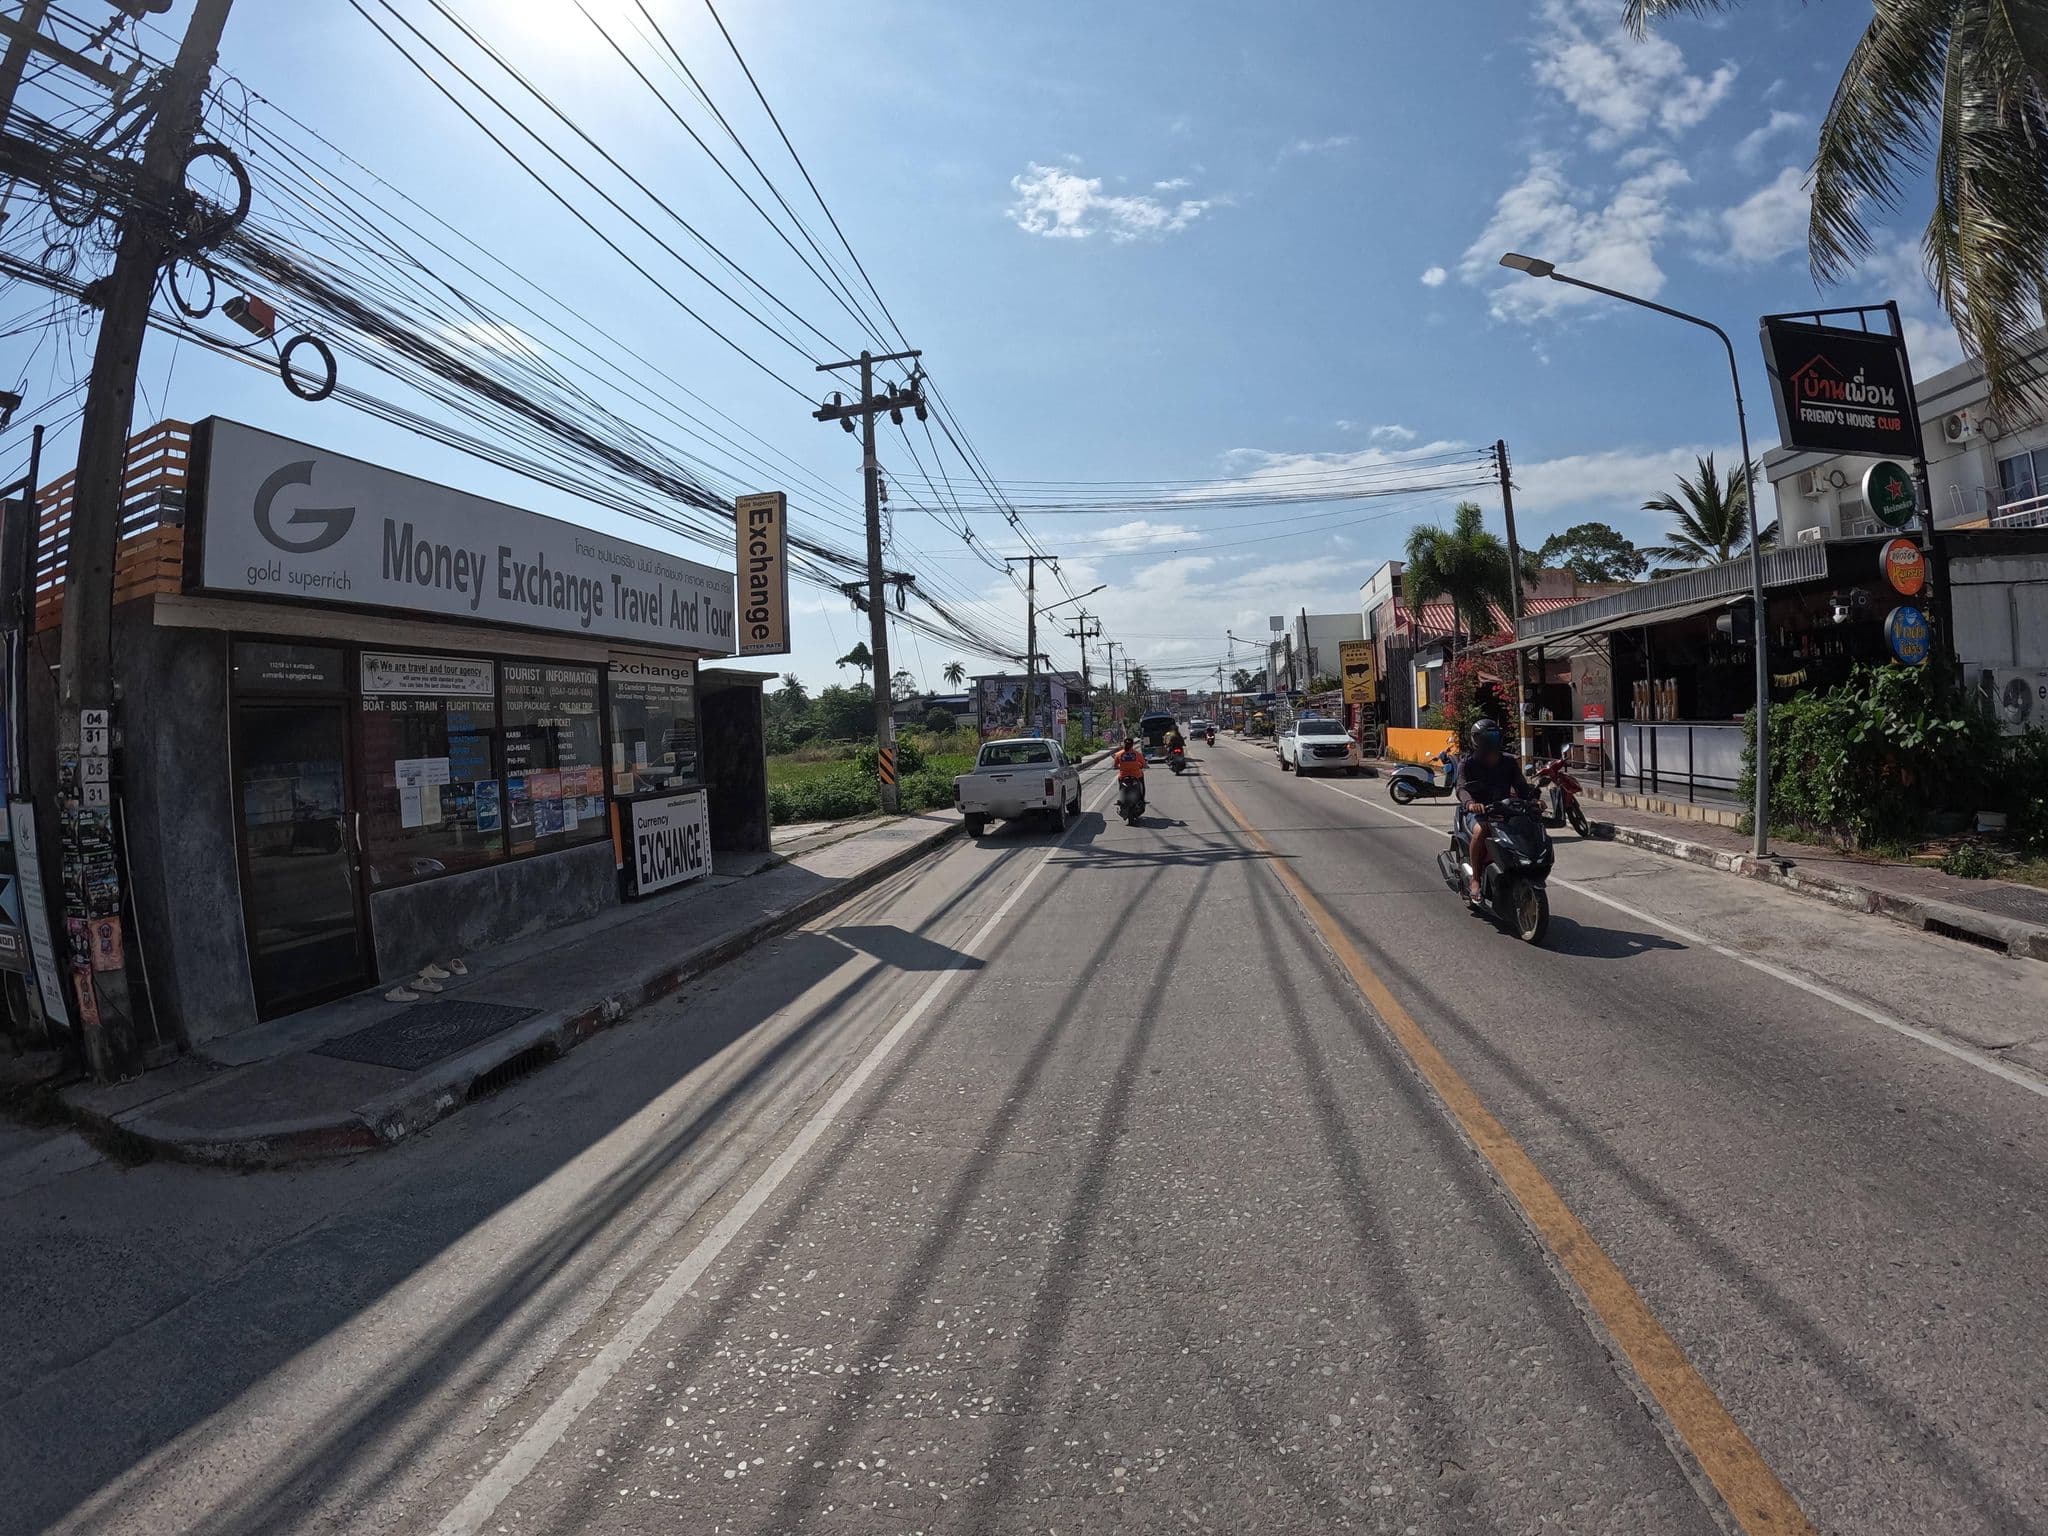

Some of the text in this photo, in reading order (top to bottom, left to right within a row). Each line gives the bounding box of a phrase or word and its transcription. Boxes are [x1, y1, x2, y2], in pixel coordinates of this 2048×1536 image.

[1804, 367, 1895, 406] บ้านเพื่อน
[1800, 408, 1901, 431] FRIEND'S HOUSE CLUB
[247, 559, 351, 591] gold superrich
[382, 518, 732, 638] Money Exchange Travel And Tour
[745, 507, 774, 640] Exchange
[380, 660, 481, 677] We are travel and tour agency
[504, 667, 598, 684] TOURIST INFORMATION
[608, 660, 689, 680] Exchange
[505, 685, 531, 695] PRIVATE
[363, 700, 384, 711] BOAT
[391, 701, 407, 711] BUS
[415, 701, 438, 711] TRAIN
[447, 701, 472, 711] FLIGHT
[472, 702, 494, 712] TICKET
[506, 701, 523, 711] TOUR
[524, 702, 550, 711] PACKAGE
[86, 713, 102, 725] 04
[86, 731, 100, 742] 31
[89, 789, 103, 800] 31
[638, 815, 669, 829] Currency
[639, 823, 703, 885] EXCHANGE
